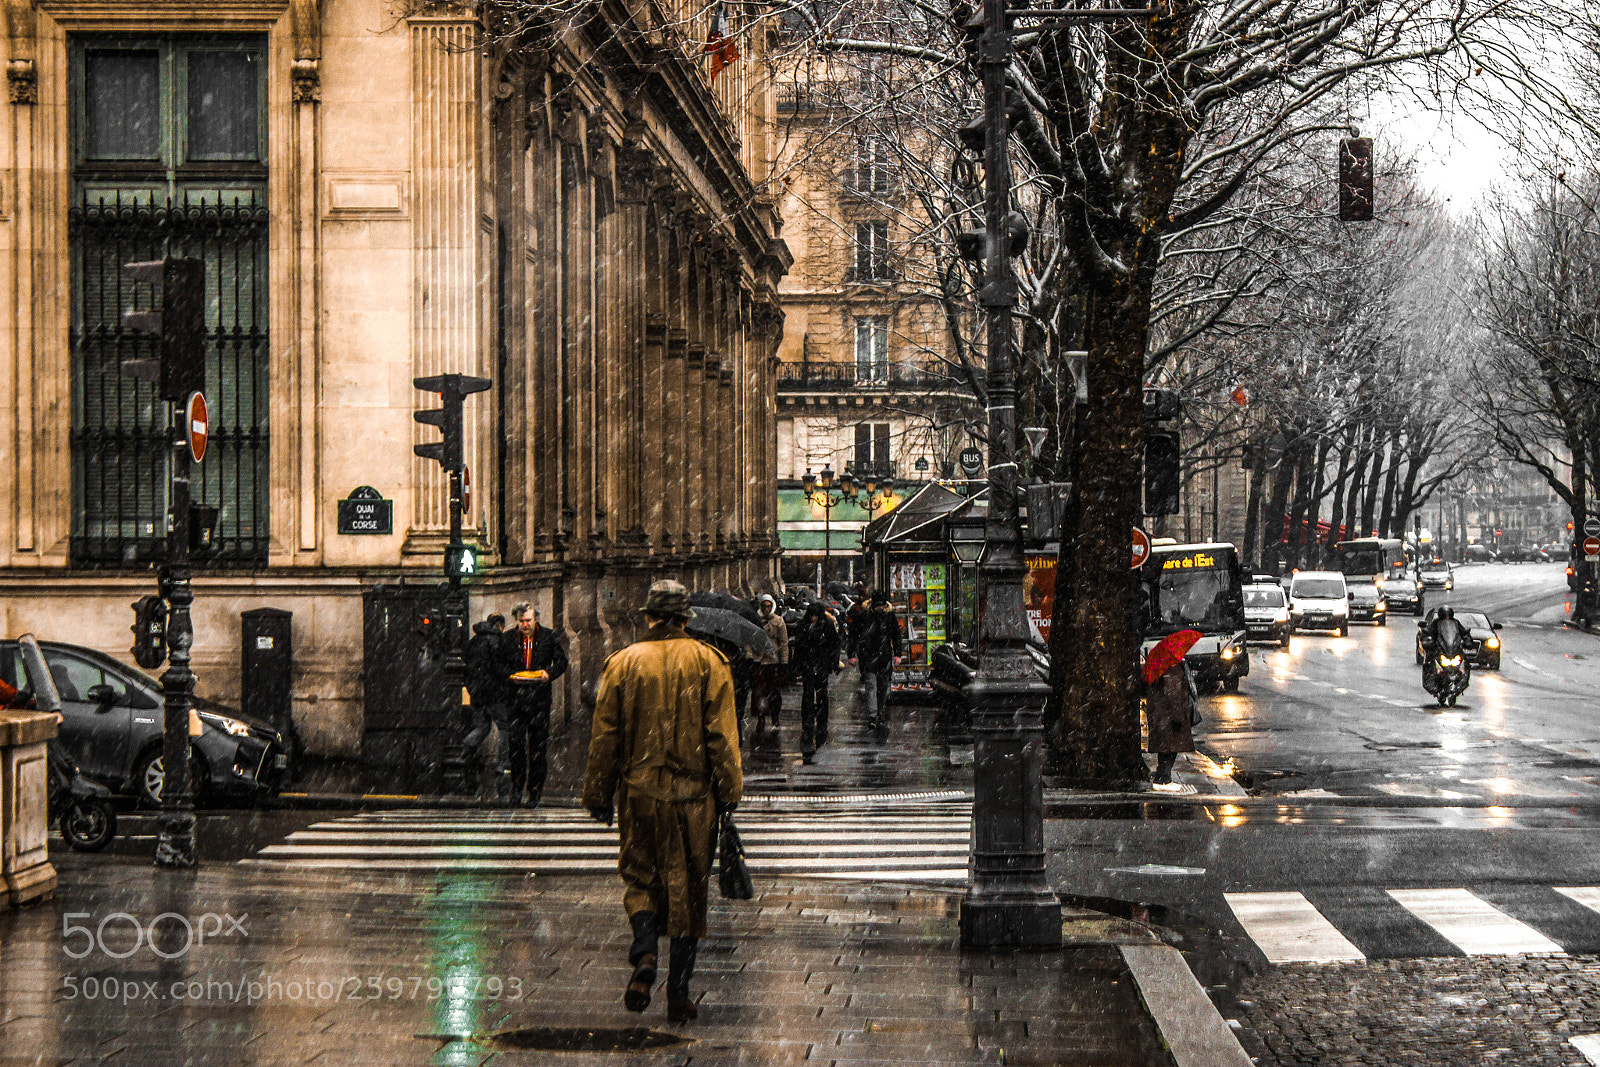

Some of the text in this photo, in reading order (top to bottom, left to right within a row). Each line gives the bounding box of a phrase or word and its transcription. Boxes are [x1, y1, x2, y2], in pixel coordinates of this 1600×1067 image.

[963, 454, 980, 463] BUS
[356, 504, 375, 514] QUAI
[352, 520, 378, 530] CORSE
[1162, 559, 1181, 570] are
[1182, 556, 1194, 569] de
